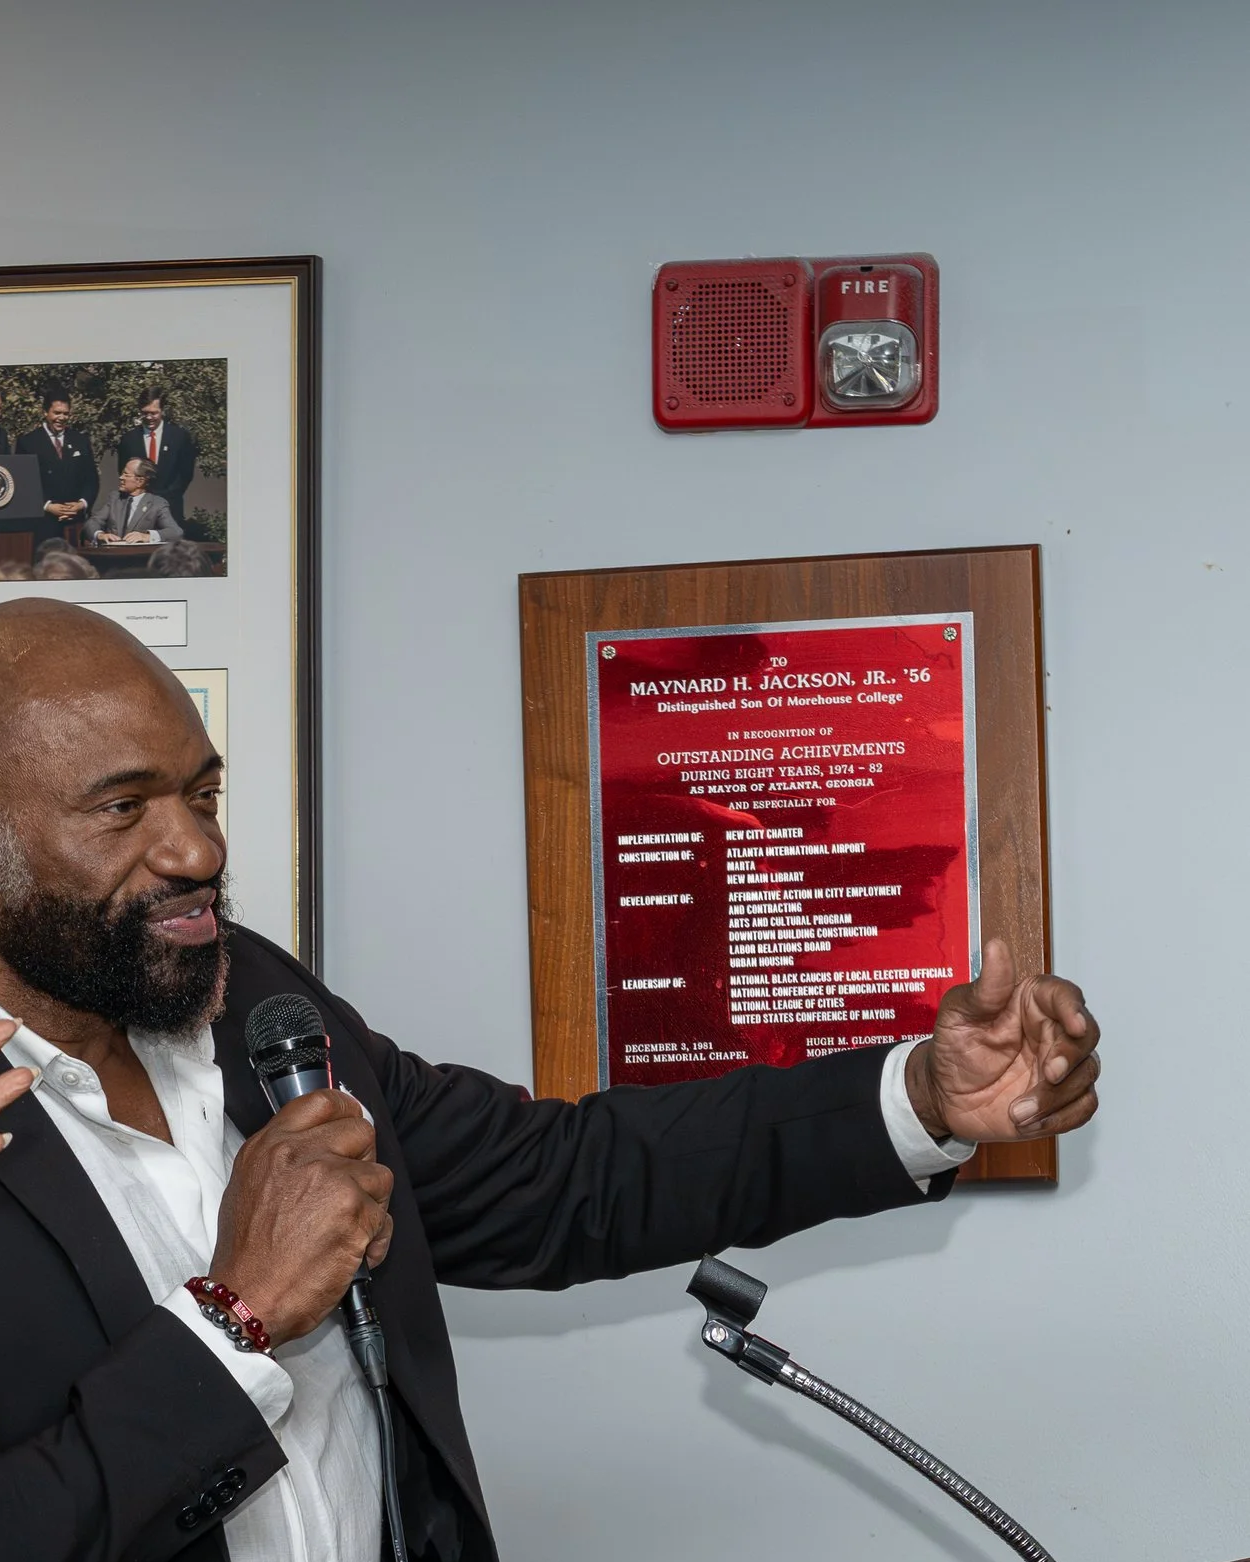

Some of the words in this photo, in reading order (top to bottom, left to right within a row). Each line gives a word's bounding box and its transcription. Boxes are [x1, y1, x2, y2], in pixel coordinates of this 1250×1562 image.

[842, 281, 888, 294] FIRE
[770, 657, 787, 667] TO
[631, 678, 726, 696] MAYNARD
[733, 677, 752, 691] H.
[760, 672, 855, 690] JACKSON,
[863, 671, 896, 685] JR.,
[658, 699, 736, 713] Distinguished
[741, 699, 762, 708] Son
[767, 697, 782, 707] Of
[787, 695, 852, 706] Morehouse
[857, 692, 903, 704] College
[728, 732, 739, 740] IN
[744, 728, 814, 739] RECOGNITION
[820, 727, 833, 735] OF
[658, 748, 773, 765] OUTSTANDING
[780, 742, 905, 759] ACHIEVEMENTS
[681, 770, 730, 781] DURING
[735, 767, 774, 779] EIGHT
[778, 765, 824, 777] YEARS,
[829, 764, 854, 774] 1974
[869, 763, 882, 773] 82
[690, 786, 704, 794] AS
[708, 784, 747, 793] MAYOR
[751, 783, 765, 791] OF
[826, 778, 874, 788] GEORGIA
[728, 802, 749, 810] AND
[753, 799, 813, 809] ESPECIALLY
[817, 798, 836, 806] FOR
[618, 833, 689, 845] IMPLEMENTATION
[691, 832, 704, 842] OF:
[726, 830, 744, 840] NEW
[746, 829, 764, 840] CITY
[766, 828, 803, 839] CHARTER
[619, 851, 679, 863] CONSTRUCTION
[681, 850, 694, 860] OF:
[727, 847, 764, 858] ATLANTA
[766, 845, 829, 856] INTERNATIONAL
[832, 843, 865, 854] AIRPORT
[727, 861, 755, 871] MARTA
[727, 874, 745, 884] NEW
[747, 873, 768, 884] MAIN
[770, 872, 804, 882] LIBRARY
[620, 895, 678, 906] DEVELOPMENT
[680, 894, 693, 904] OF:
[729, 890, 781, 902] AFFIRMATIVE
[783, 889, 812, 900] ACTION
[814, 889, 823, 899] IN
[825, 888, 843, 898] CITY
[846, 885, 901, 897] EMPLOYMENT
[729, 905, 745, 915] AND
[747, 902, 802, 914] CONTRACTING
[729, 918, 750, 928] ARTS
[752, 917, 768, 927] AND
[770, 916, 811, 926] CULTURAL
[813, 914, 852, 925] PROGRAM
[729, 930, 776, 941] DOWNTOWN
[778, 928, 815, 939] BUILDING
[817, 926, 878, 938] CONSTRUCTION
[730, 944, 756, 954] LABOR
[758, 942, 802, 953] RELATIONS
[804, 941, 831, 952] BOARD
[730, 957, 757, 968] URBAN
[759, 956, 794, 967] HOUSING
[730, 975, 769, 985] NATIONAL
[772, 973, 798, 984] BLACK
[800, 972, 832, 983] CAUCUS
[834, 972, 844, 981] OF
[846, 971, 872, 981] LOCAL
[874, 969, 909, 980] ELECTED
[911, 967, 953, 978] OFFICIALS
[623, 978, 671, 989] LEADERSHIP
[673, 978, 686, 988] OF:
[731, 988, 770, 998] NATIONAL
[772, 986, 824, 996] CONFERENCE
[826, 985, 836, 995] OF
[838, 983, 890, 994] DEMOCRATIC
[892, 982, 925, 992] MAYORS
[731, 1001, 771, 1011] NATIONAL
[773, 999, 803, 1010] LEAGUE
[805, 999, 815, 1008] OF
[818, 998, 844, 1008] CITIES
[732, 1014, 761, 1024] UNITED
[763, 1013, 794, 1023] STATES
[796, 1011, 847, 1022] CONFERENCE
[850, 1010, 860, 1020] OF
[862, 1009, 895, 1020] MAYORS
[625, 1043, 677, 1053] DECEMBER
[693, 1042, 713, 1050] 1981
[807, 1037, 834, 1046] HUGH
[838, 1037, 848, 1045] M.
[625, 1055, 649, 1063] KING
[653, 1053, 706, 1062] MEMORIAL
[709, 1051, 748, 1060] CHAPEL
